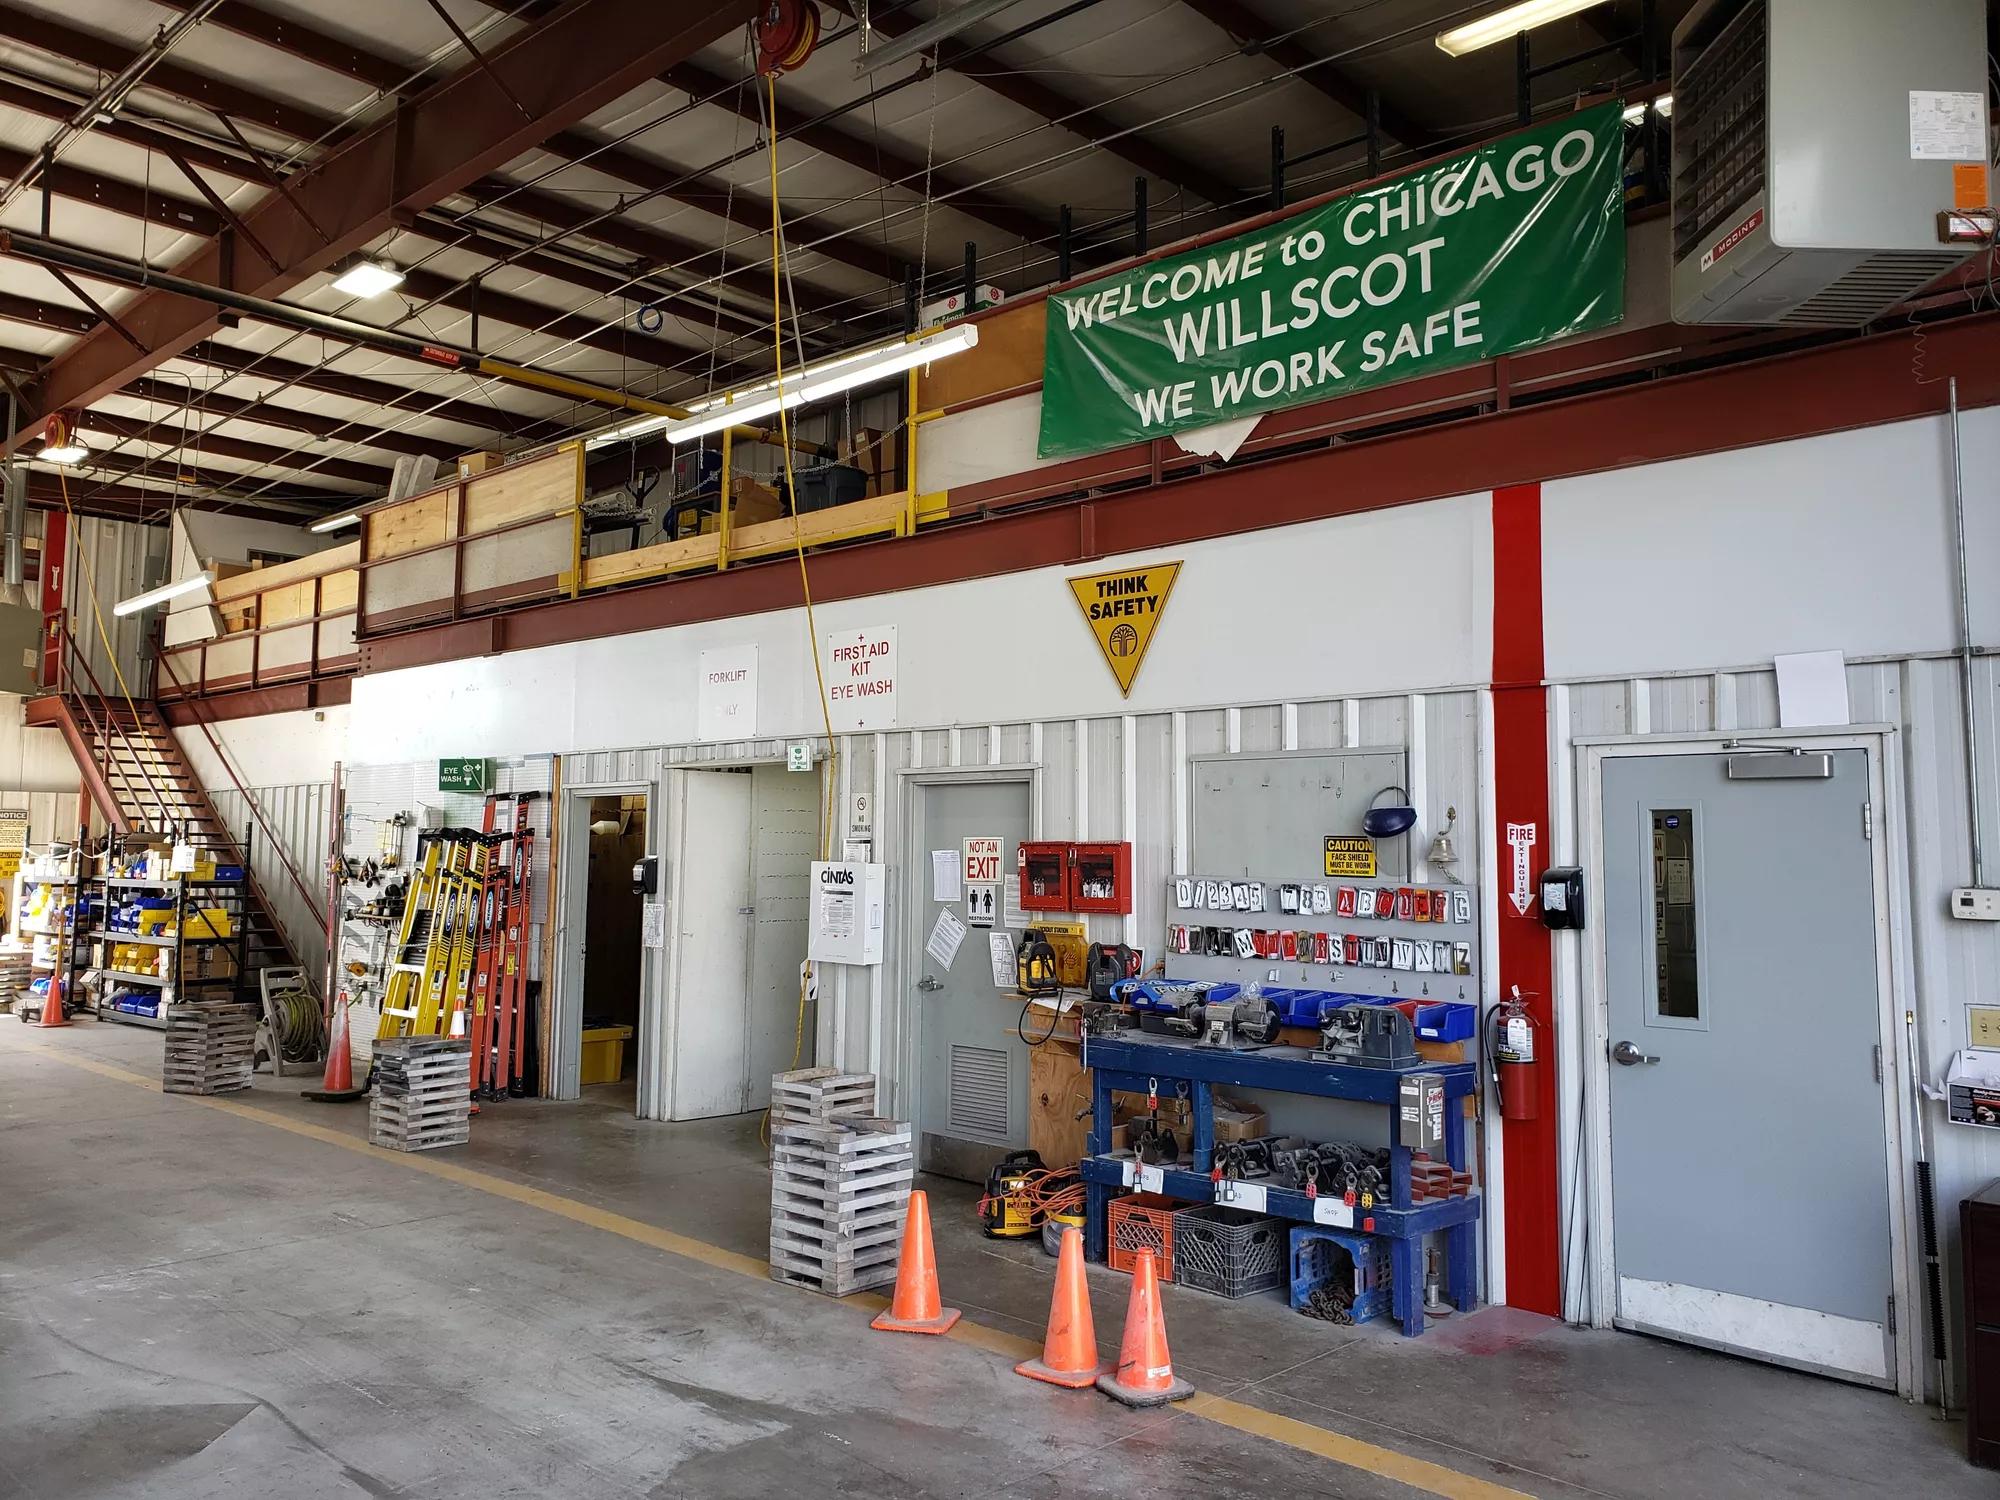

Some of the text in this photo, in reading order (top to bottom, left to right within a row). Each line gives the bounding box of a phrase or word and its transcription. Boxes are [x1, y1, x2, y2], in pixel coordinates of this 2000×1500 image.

[1064, 129, 1595, 333] WELCOME to CHICAGO
[1718, 217, 1757, 253] MODINE
[1164, 237, 1446, 363] WILLSCOT
[1134, 301, 1484, 427] WE WORK SAFE
[1096, 575, 1148, 598] THINK
[1090, 595, 1158, 620] SAFETY
[834, 642, 890, 662] FIRST AID
[708, 670, 747, 684] FORKLIFT
[852, 661, 870, 676] KIT
[831, 680, 892, 700] EYE WASH
[1509, 829, 1533, 840] FIRE
[970, 842, 998, 853] NOT AN
[1328, 840, 1372, 851] CAUTION
[967, 857, 999, 878] EXIT
